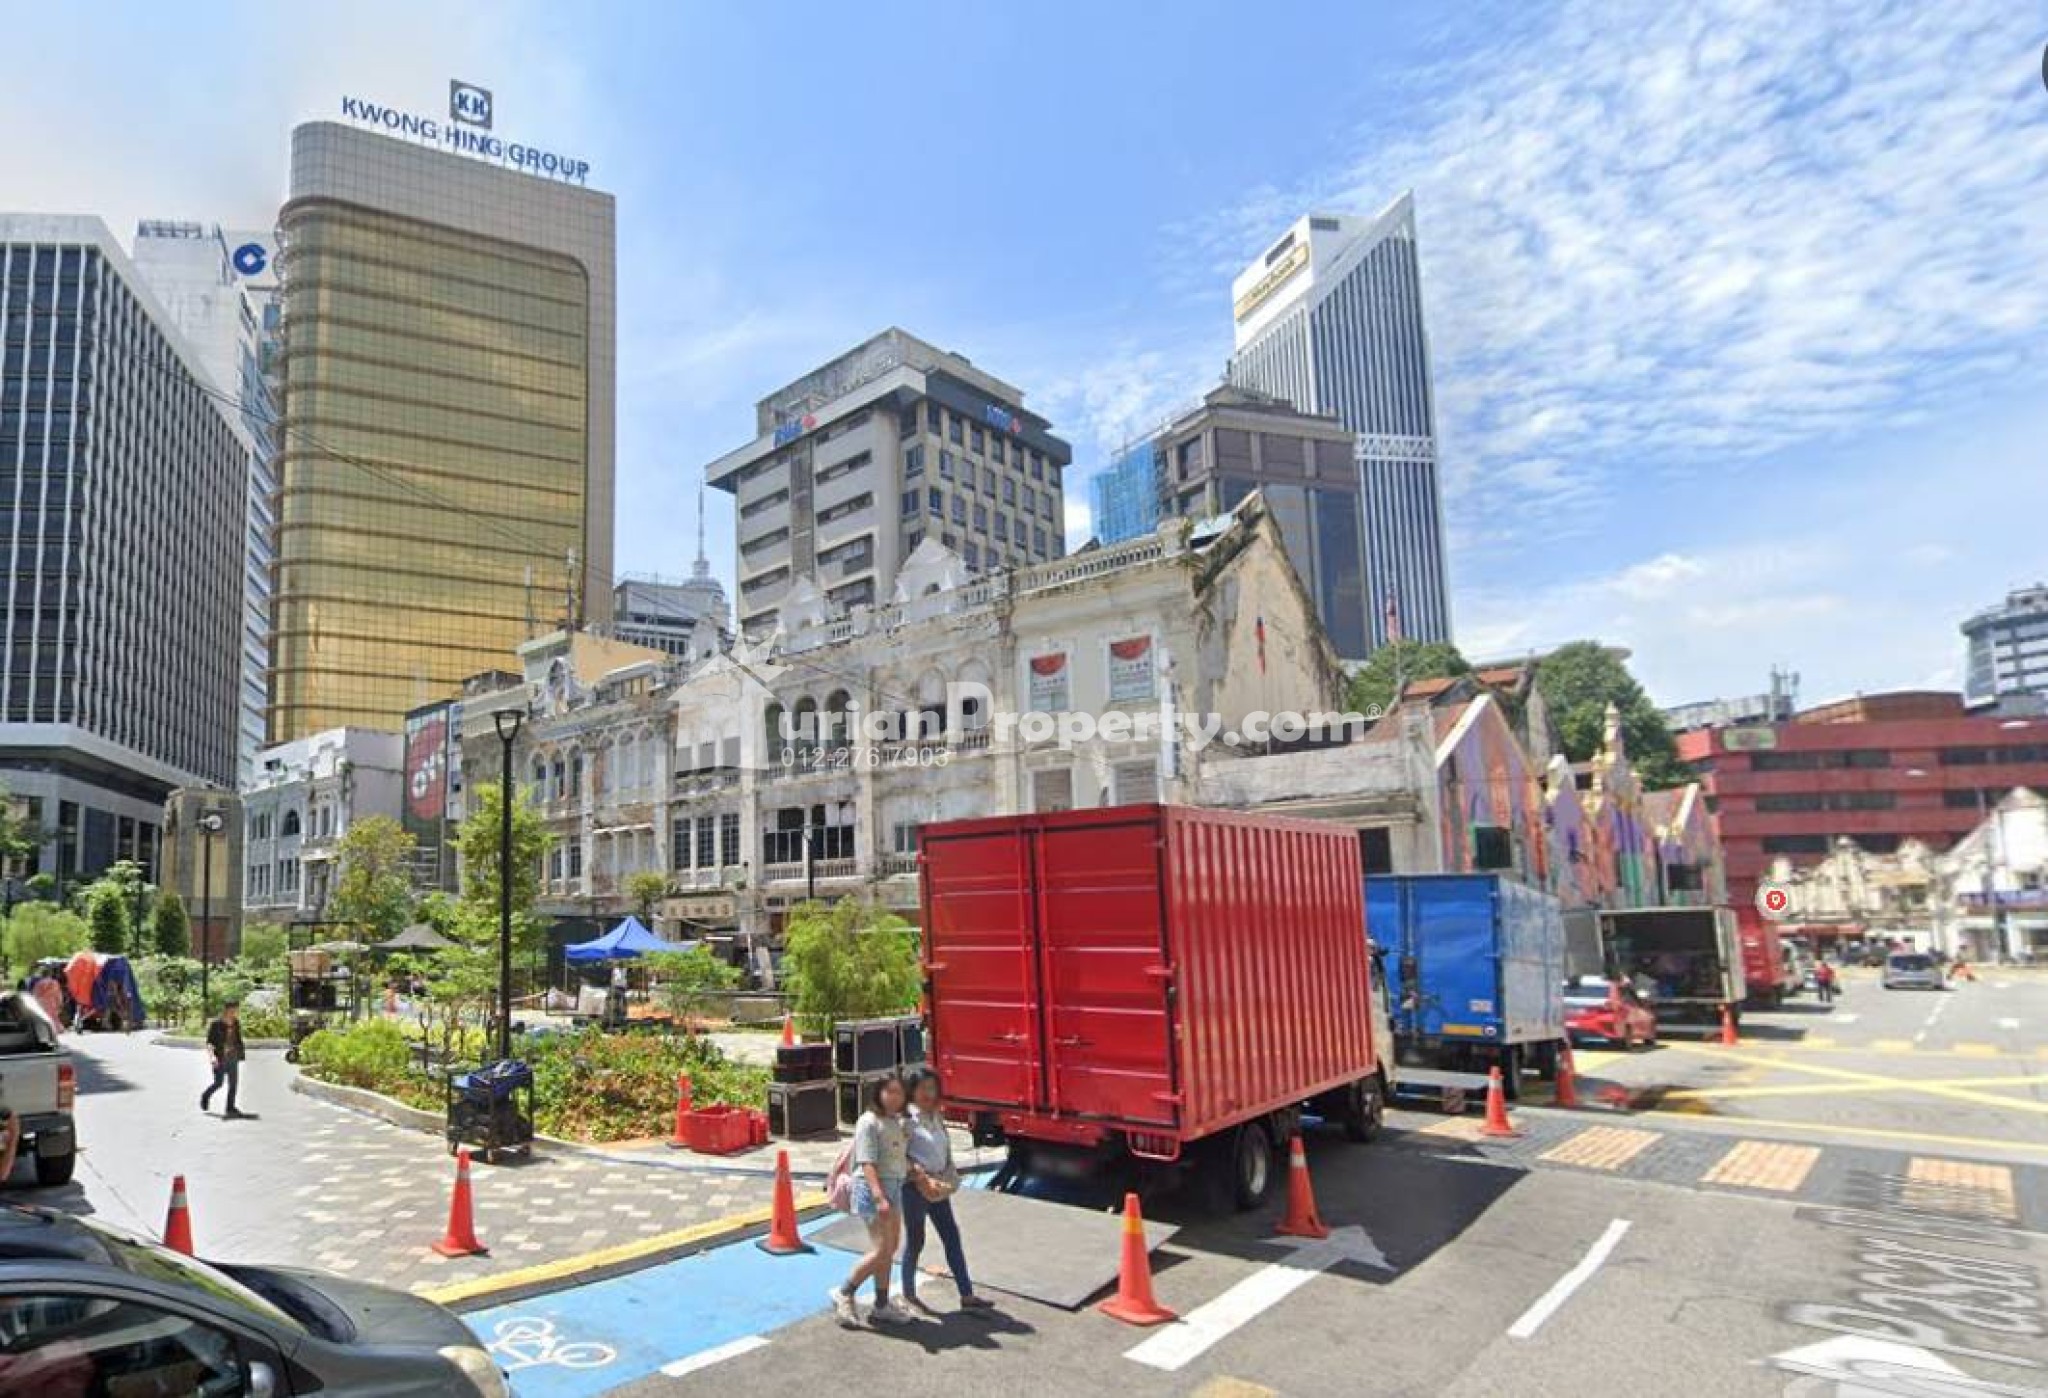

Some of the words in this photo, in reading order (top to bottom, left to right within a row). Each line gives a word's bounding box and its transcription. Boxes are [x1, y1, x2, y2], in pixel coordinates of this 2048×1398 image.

[457, 92, 486, 116] KH
[342, 96, 437, 140] KWONG
[446, 127, 502, 157] HING
[509, 144, 590, 180] GROUP
